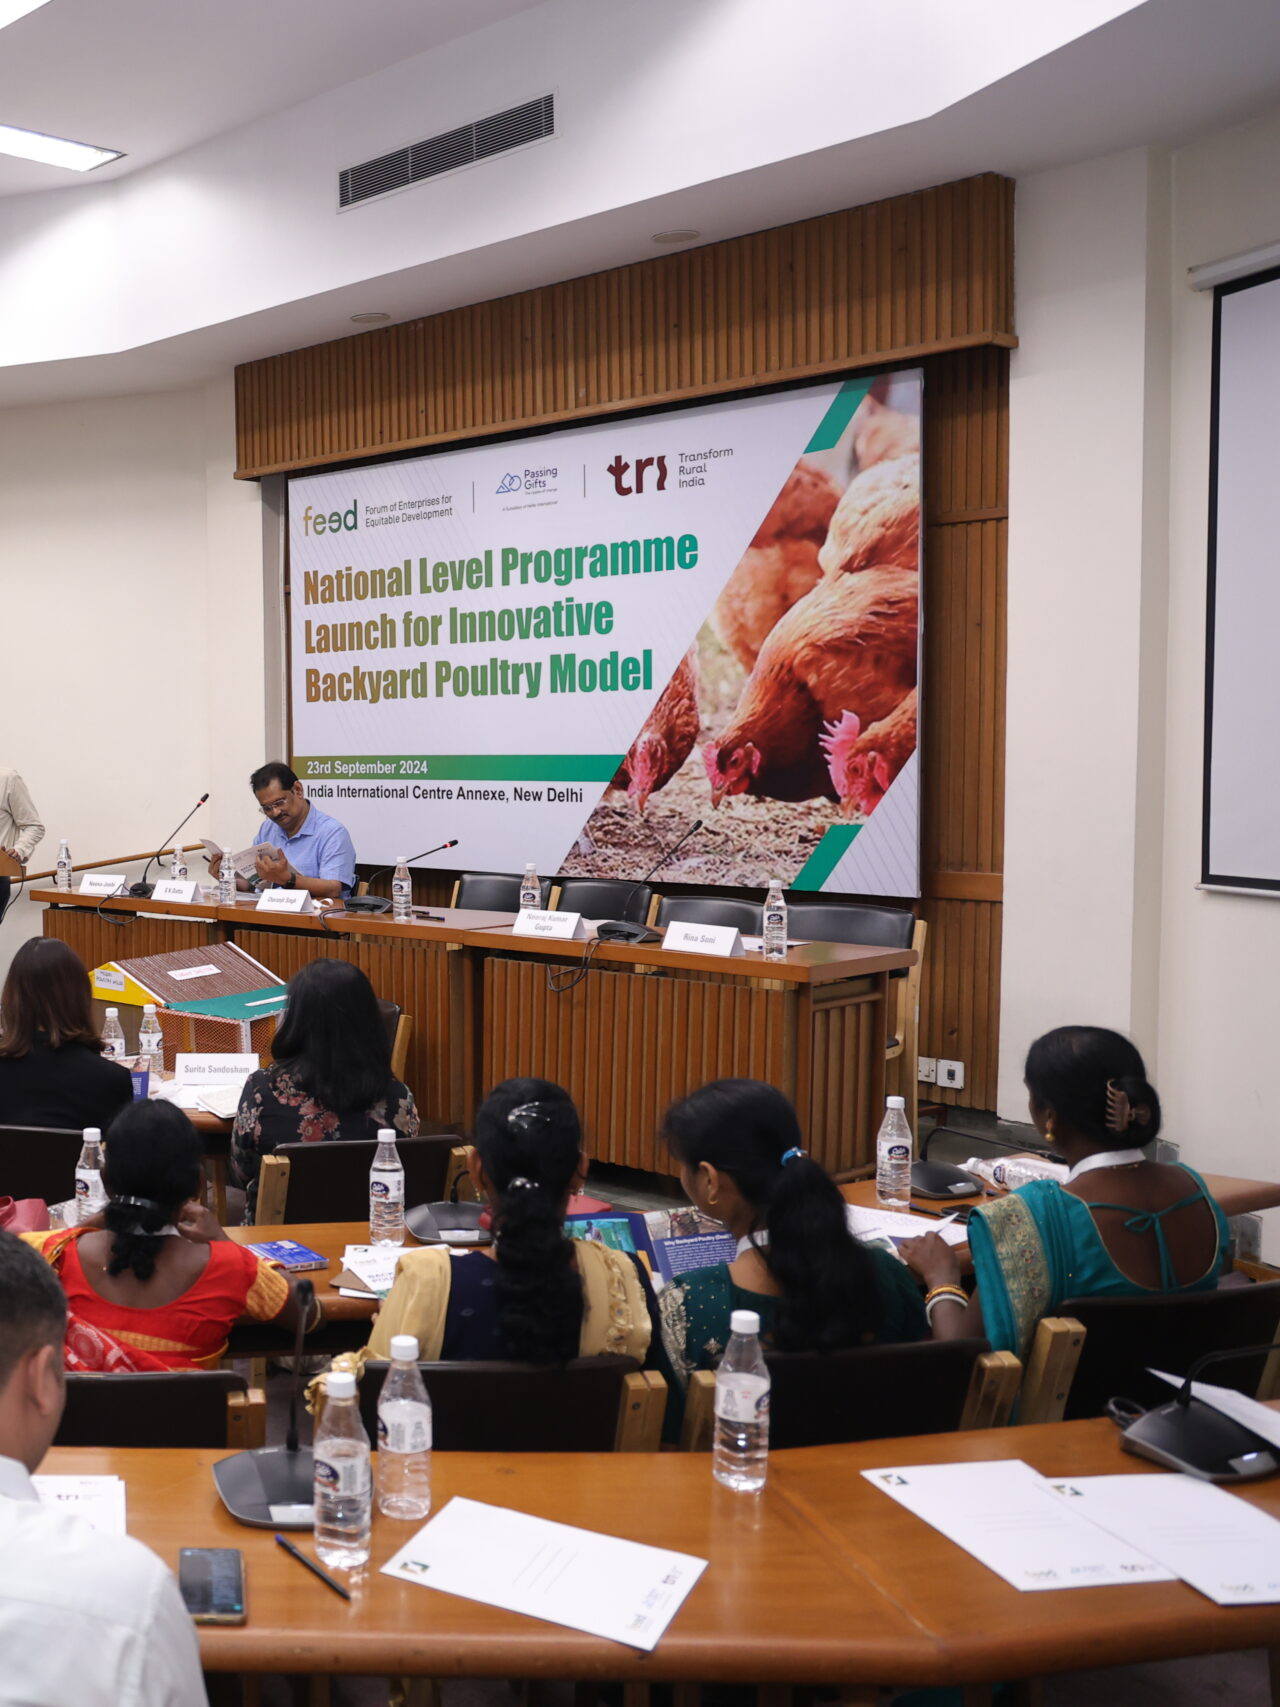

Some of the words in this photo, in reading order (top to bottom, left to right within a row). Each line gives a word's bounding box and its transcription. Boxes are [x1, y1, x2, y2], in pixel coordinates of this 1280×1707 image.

[678, 448, 734, 463] Transform
[524, 466, 558, 478] Passing
[678, 463, 708, 476] Rural
[524, 479, 546, 490] Gifts
[678, 477, 705, 488] India
[365, 505, 388, 516] Forum
[389, 502, 397, 512] of
[398, 498, 440, 511] Enterprises
[441, 495, 453, 504] for
[365, 514, 400, 528] Equitable
[401, 508, 453, 523] Development
[304, 559, 412, 606] National
[419, 549, 493, 594] Level
[501, 534, 698, 586] Programme
[304, 613, 396, 654] Launch
[402, 610, 442, 648] for
[450, 596, 614, 644] Innovative
[306, 662, 428, 704] Backyard
[435, 658, 542, 699] Poultry
[550, 648, 652, 694] Model
[306, 760, 331, 774] 23rd
[334, 760, 396, 776] September
[399, 760, 428, 774] 2024
[307, 785, 334, 798] India
[336, 785, 409, 799] International
[412, 785, 453, 800] Centre
[456, 786, 509, 804] Annexe,
[513, 787, 543, 802] New
[547, 788, 583, 802] Delhi
[184, 1064, 206, 1073] Surita
[208, 1065, 250, 1074] Sandosham
